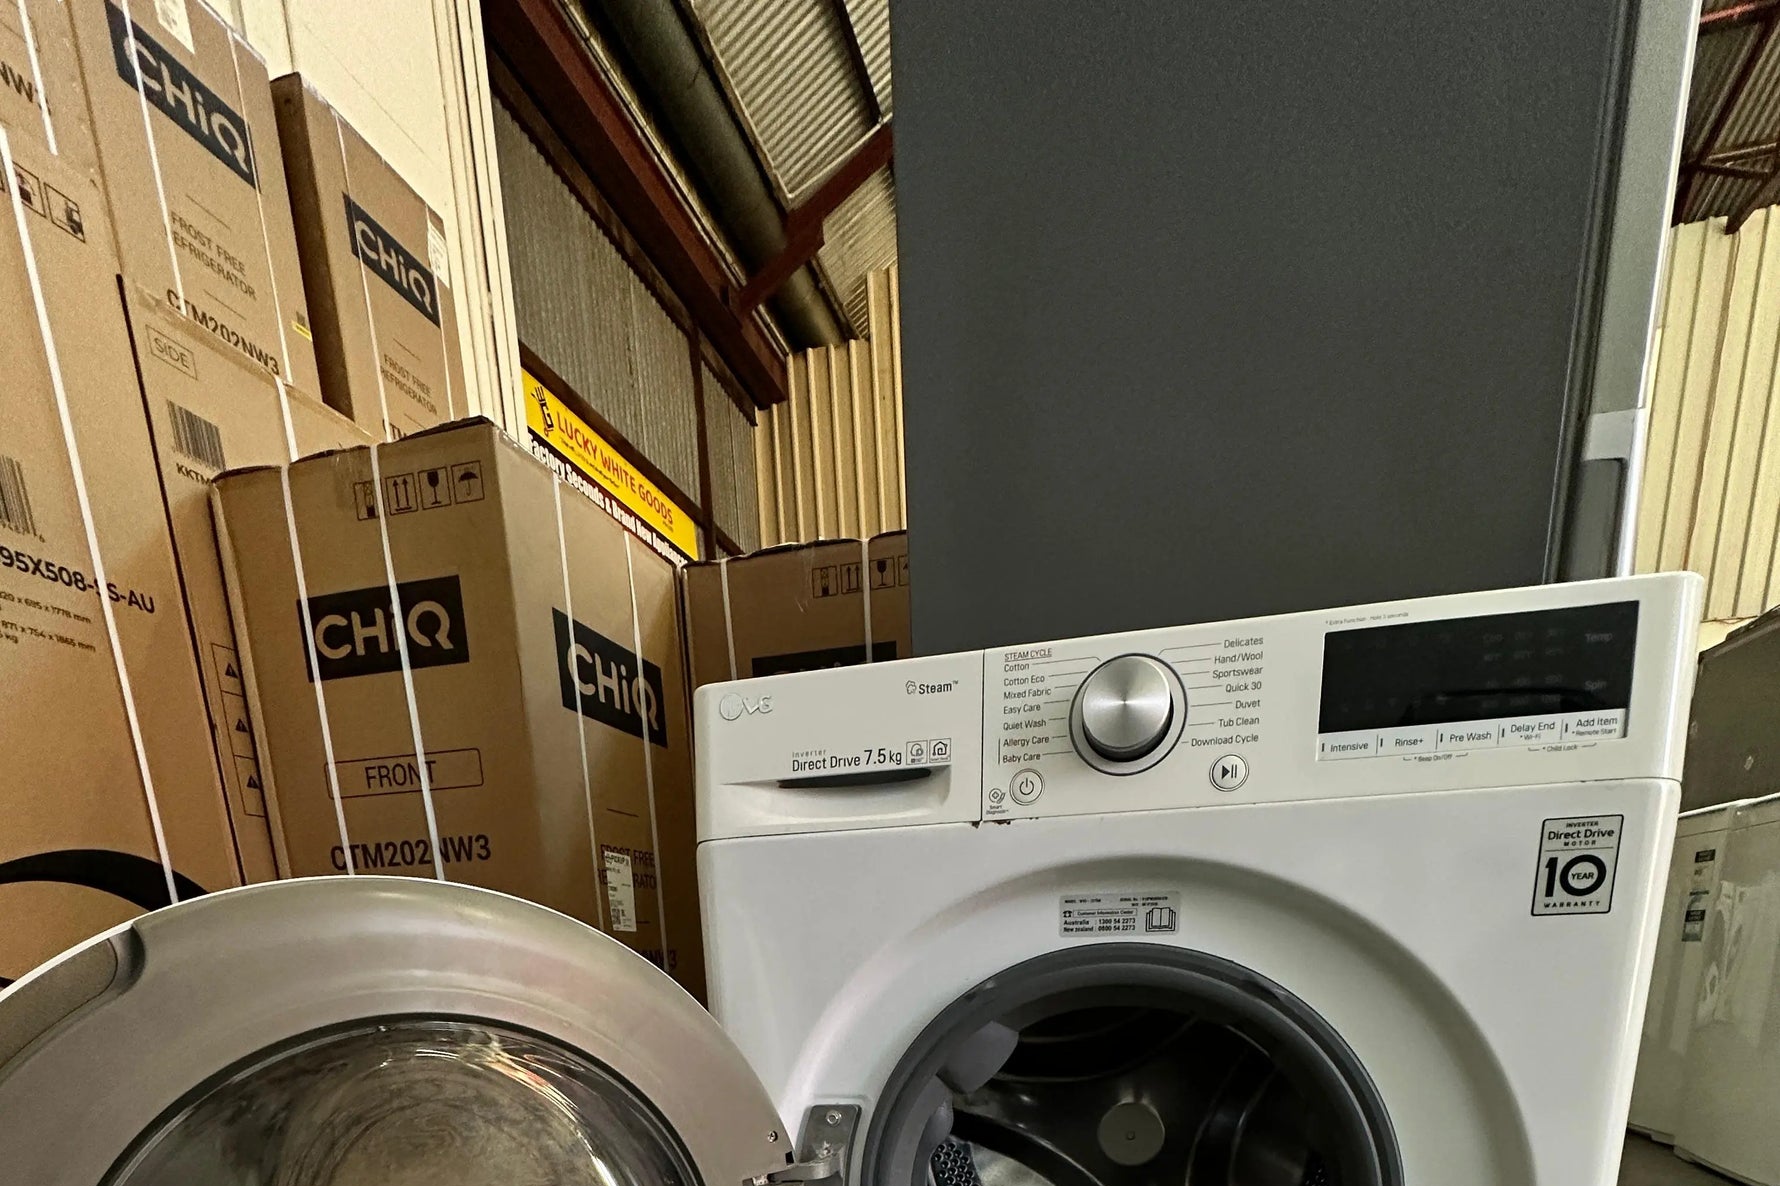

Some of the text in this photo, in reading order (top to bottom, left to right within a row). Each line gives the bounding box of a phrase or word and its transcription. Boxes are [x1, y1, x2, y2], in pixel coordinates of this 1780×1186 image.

[124, 36, 249, 174] CHiQ
[171, 211, 246, 276] FROST FREE
[172, 231, 257, 300] EFRIGERATOR
[355, 221, 433, 314] CHiQ
[557, 411, 598, 459] LUCKY
[600, 454, 636, 495] WHITE
[638, 483, 674, 525] GOODS
[566, 463, 605, 509] Seconds
[315, 600, 454, 659] CHiQ
[1224, 637, 1264, 648] Delicates
[1005, 648, 1052, 660] STEAM CYCLE
[1214, 651, 1264, 664] Hand/Wool
[1004, 663, 1030, 672] Cotton
[1212, 667, 1264, 679] Sportswear
[567, 642, 659, 730] CHiQ
[1004, 675, 1045, 686] Cotton Eco
[1225, 680, 1262, 693] Quick 30
[1004, 688, 1052, 700] Mixed Fabric
[1003, 703, 1041, 715] Easy Care
[1235, 700, 1260, 709] Duvet
[1003, 718, 1047, 731] Quiet Wash
[1218, 717, 1260, 727] Tub Clean
[1511, 722, 1555, 733] Delay End
[1576, 717, 1618, 727] Add Item
[1003, 736, 1050, 747] Allergy Care
[1191, 733, 1259, 747] Download Cycle
[1395, 738, 1423, 746] Rinse+
[1450, 731, 1492, 742] Pre Wash
[1330, 742, 1369, 752] Intensive
[792, 759, 827, 771] Direct
[830, 756, 861, 768] Drive
[864, 748, 886, 765] 7.5
[889, 750, 902, 765] kg
[1002, 753, 1041, 763] Baby Care
[365, 760, 437, 789] FRONT
[1548, 829, 1614, 840] Direct Drive
[331, 834, 492, 871] CTM202NW3
[1545, 854, 1607, 897] 10
[1571, 872, 1595, 880] YEAR
